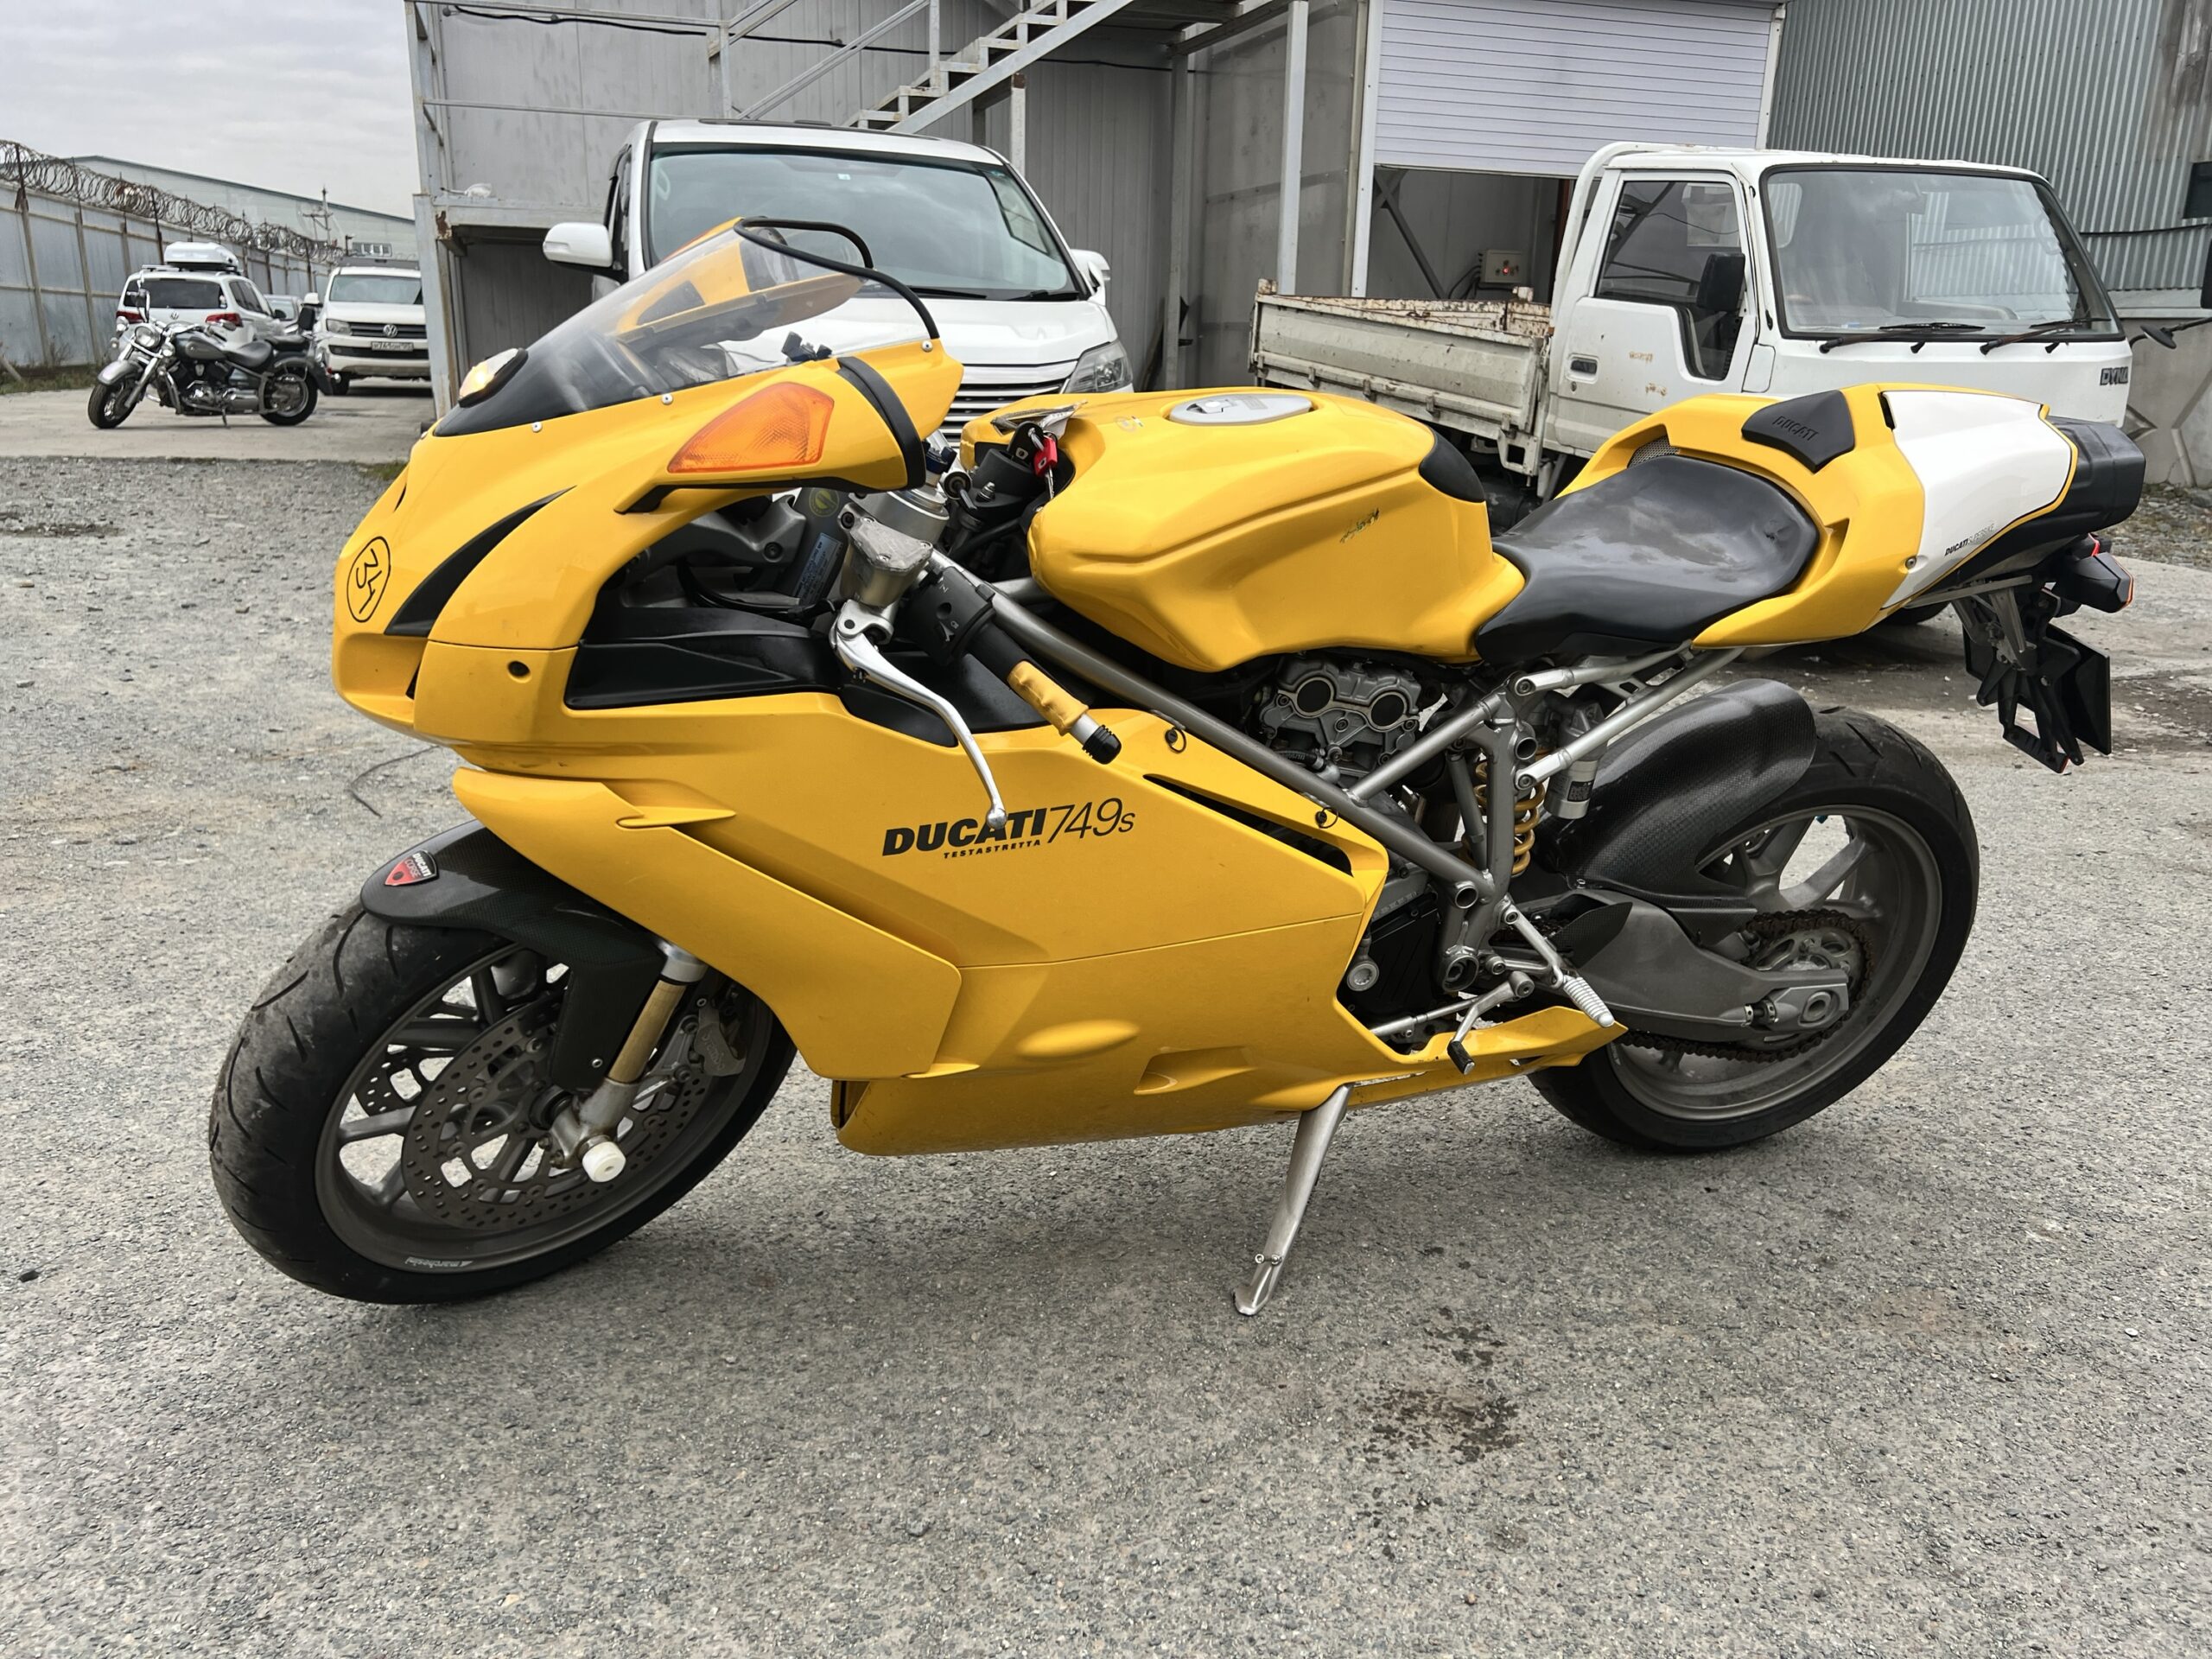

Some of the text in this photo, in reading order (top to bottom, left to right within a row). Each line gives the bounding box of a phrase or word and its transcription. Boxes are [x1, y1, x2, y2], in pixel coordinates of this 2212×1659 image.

[1944, 537, 1968, 556] DUCATI
[882, 798, 1136, 856] DUCATI 749s
[943, 839, 1041, 859] TESTASTRETTA
[412, 852, 432, 877] DUCATI
